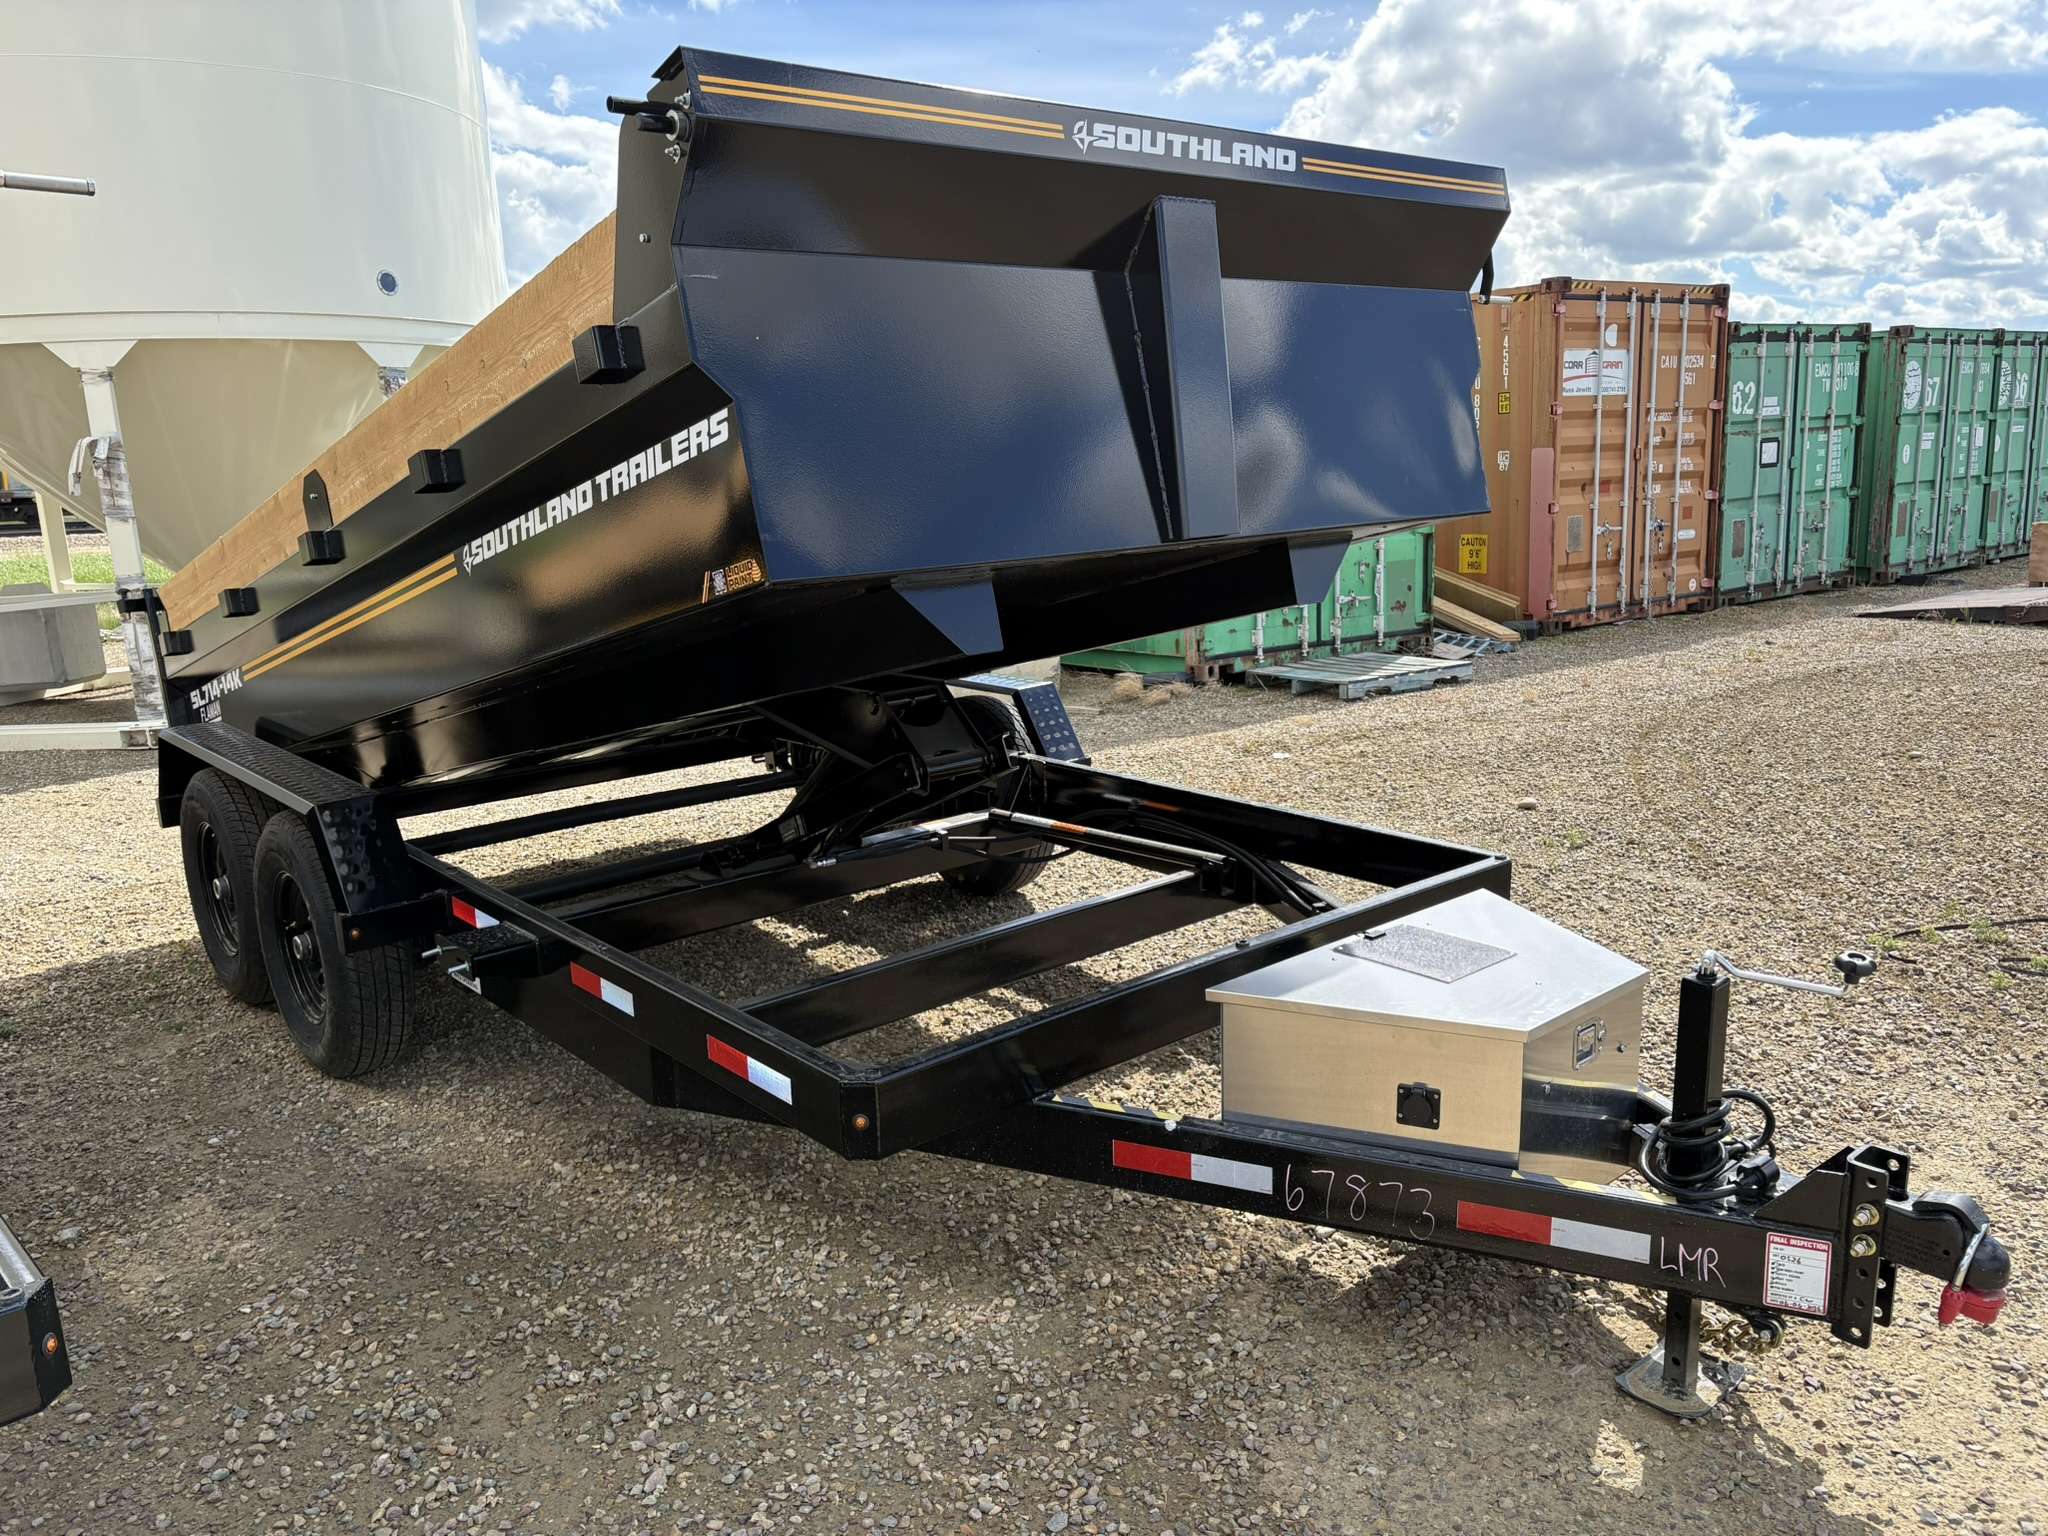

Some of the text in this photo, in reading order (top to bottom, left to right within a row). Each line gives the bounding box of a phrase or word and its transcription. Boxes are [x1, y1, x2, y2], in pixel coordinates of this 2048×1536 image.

[1092, 122, 1297, 173] SOUTHLAND
[1563, 360, 1584, 370] CORR
[1660, 354, 1678, 369] CAIU
[1682, 354, 1704, 369] 02534
[1732, 380, 1756, 415] 62
[471, 407, 729, 567] SOUTHLAND TRAILERS
[726, 560, 754, 579] LIQUID
[728, 571, 754, 589] PAINT
[189, 668, 243, 710] SL714-14K
[1285, 1163, 1436, 1241] 67873
[1769, 1235, 1789, 1246] FINAL
[1789, 1239, 1829, 1252] INSPECTION
[1660, 1235, 1727, 1289] LMR
